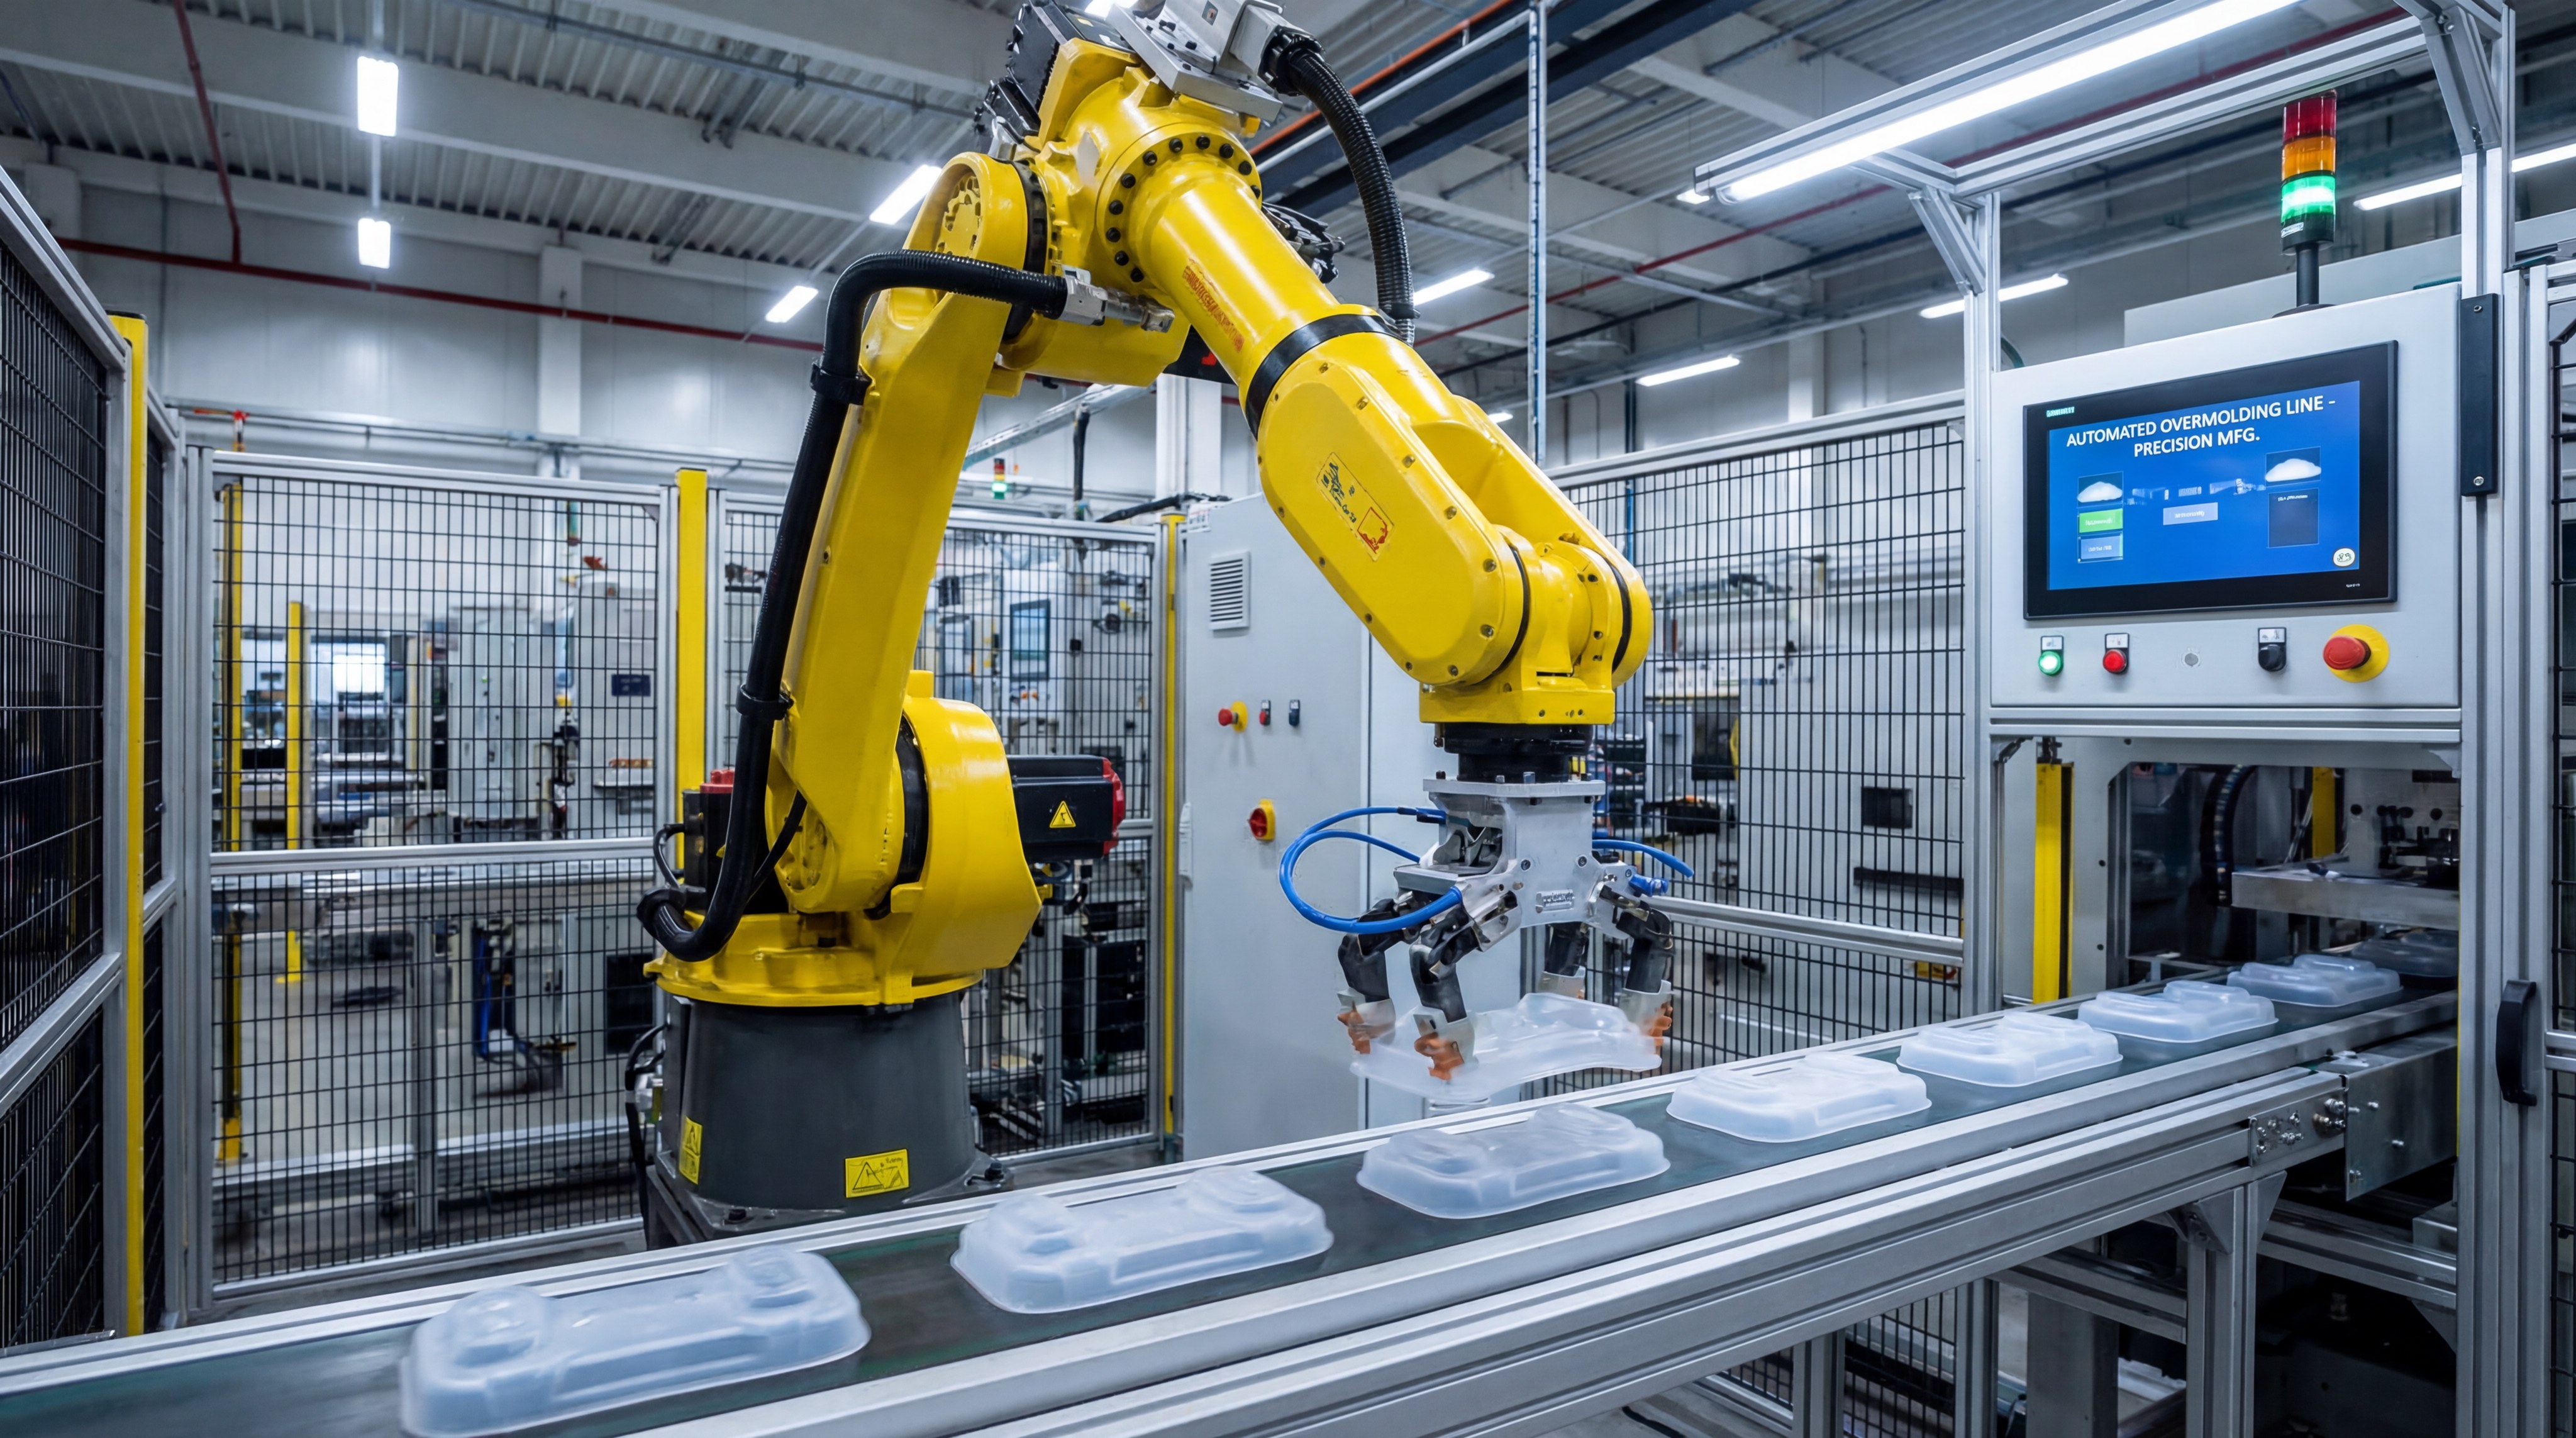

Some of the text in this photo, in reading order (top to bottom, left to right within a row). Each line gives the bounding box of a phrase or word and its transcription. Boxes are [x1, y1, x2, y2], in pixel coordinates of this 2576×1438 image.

[2066, 421, 2157, 447] AUTOMATED
[2160, 402, 2282, 433] OVERMOLDING
[2287, 395, 2324, 415] LINE
[2133, 427, 2260, 457] PRECISION MFG.
